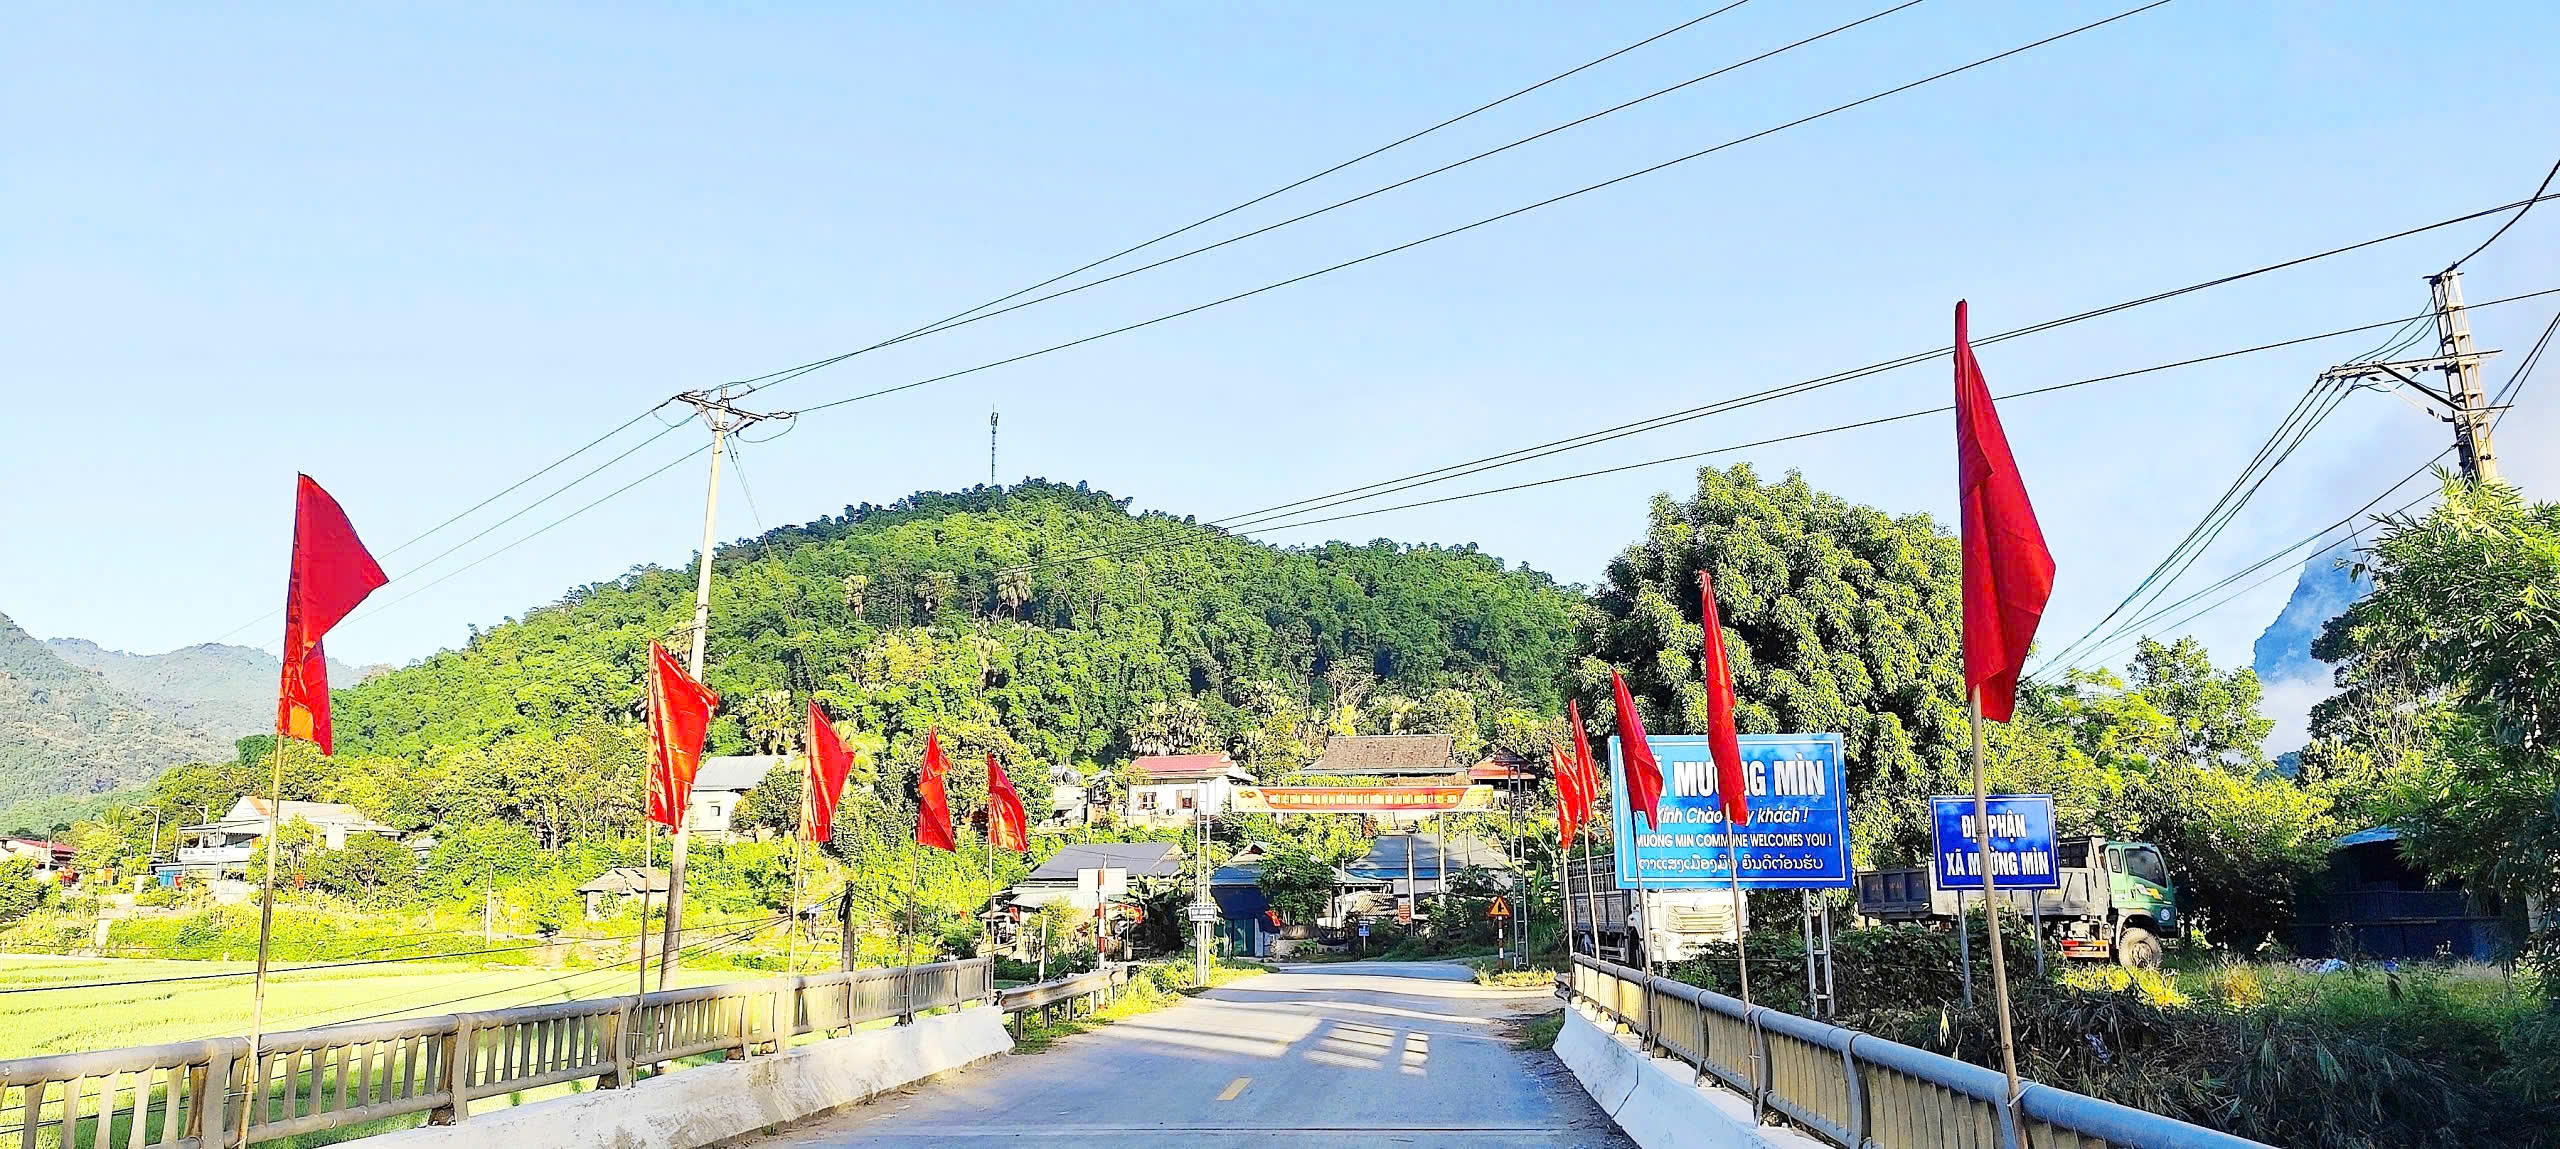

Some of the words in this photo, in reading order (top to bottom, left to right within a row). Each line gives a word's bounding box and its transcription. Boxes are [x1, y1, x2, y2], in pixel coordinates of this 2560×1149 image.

[1673, 760, 1766, 796] MƯG
[1773, 752, 1825, 796] MÌN
[1686, 805, 1723, 824] Chào
[1757, 804, 1800, 823] khách
[1961, 814, 1980, 843] ĐỊ
[1988, 810, 2027, 843] PHẬN
[1637, 833, 1673, 848] MUONG
[1675, 833, 1694, 848] MIN
[1750, 833, 1803, 848] WELCOMES
[1805, 833, 1825, 847] YOU
[1945, 849, 1965, 876] XÃ
[1967, 846, 2018, 875] MỜNG
[2020, 847, 2049, 875] MÌN
